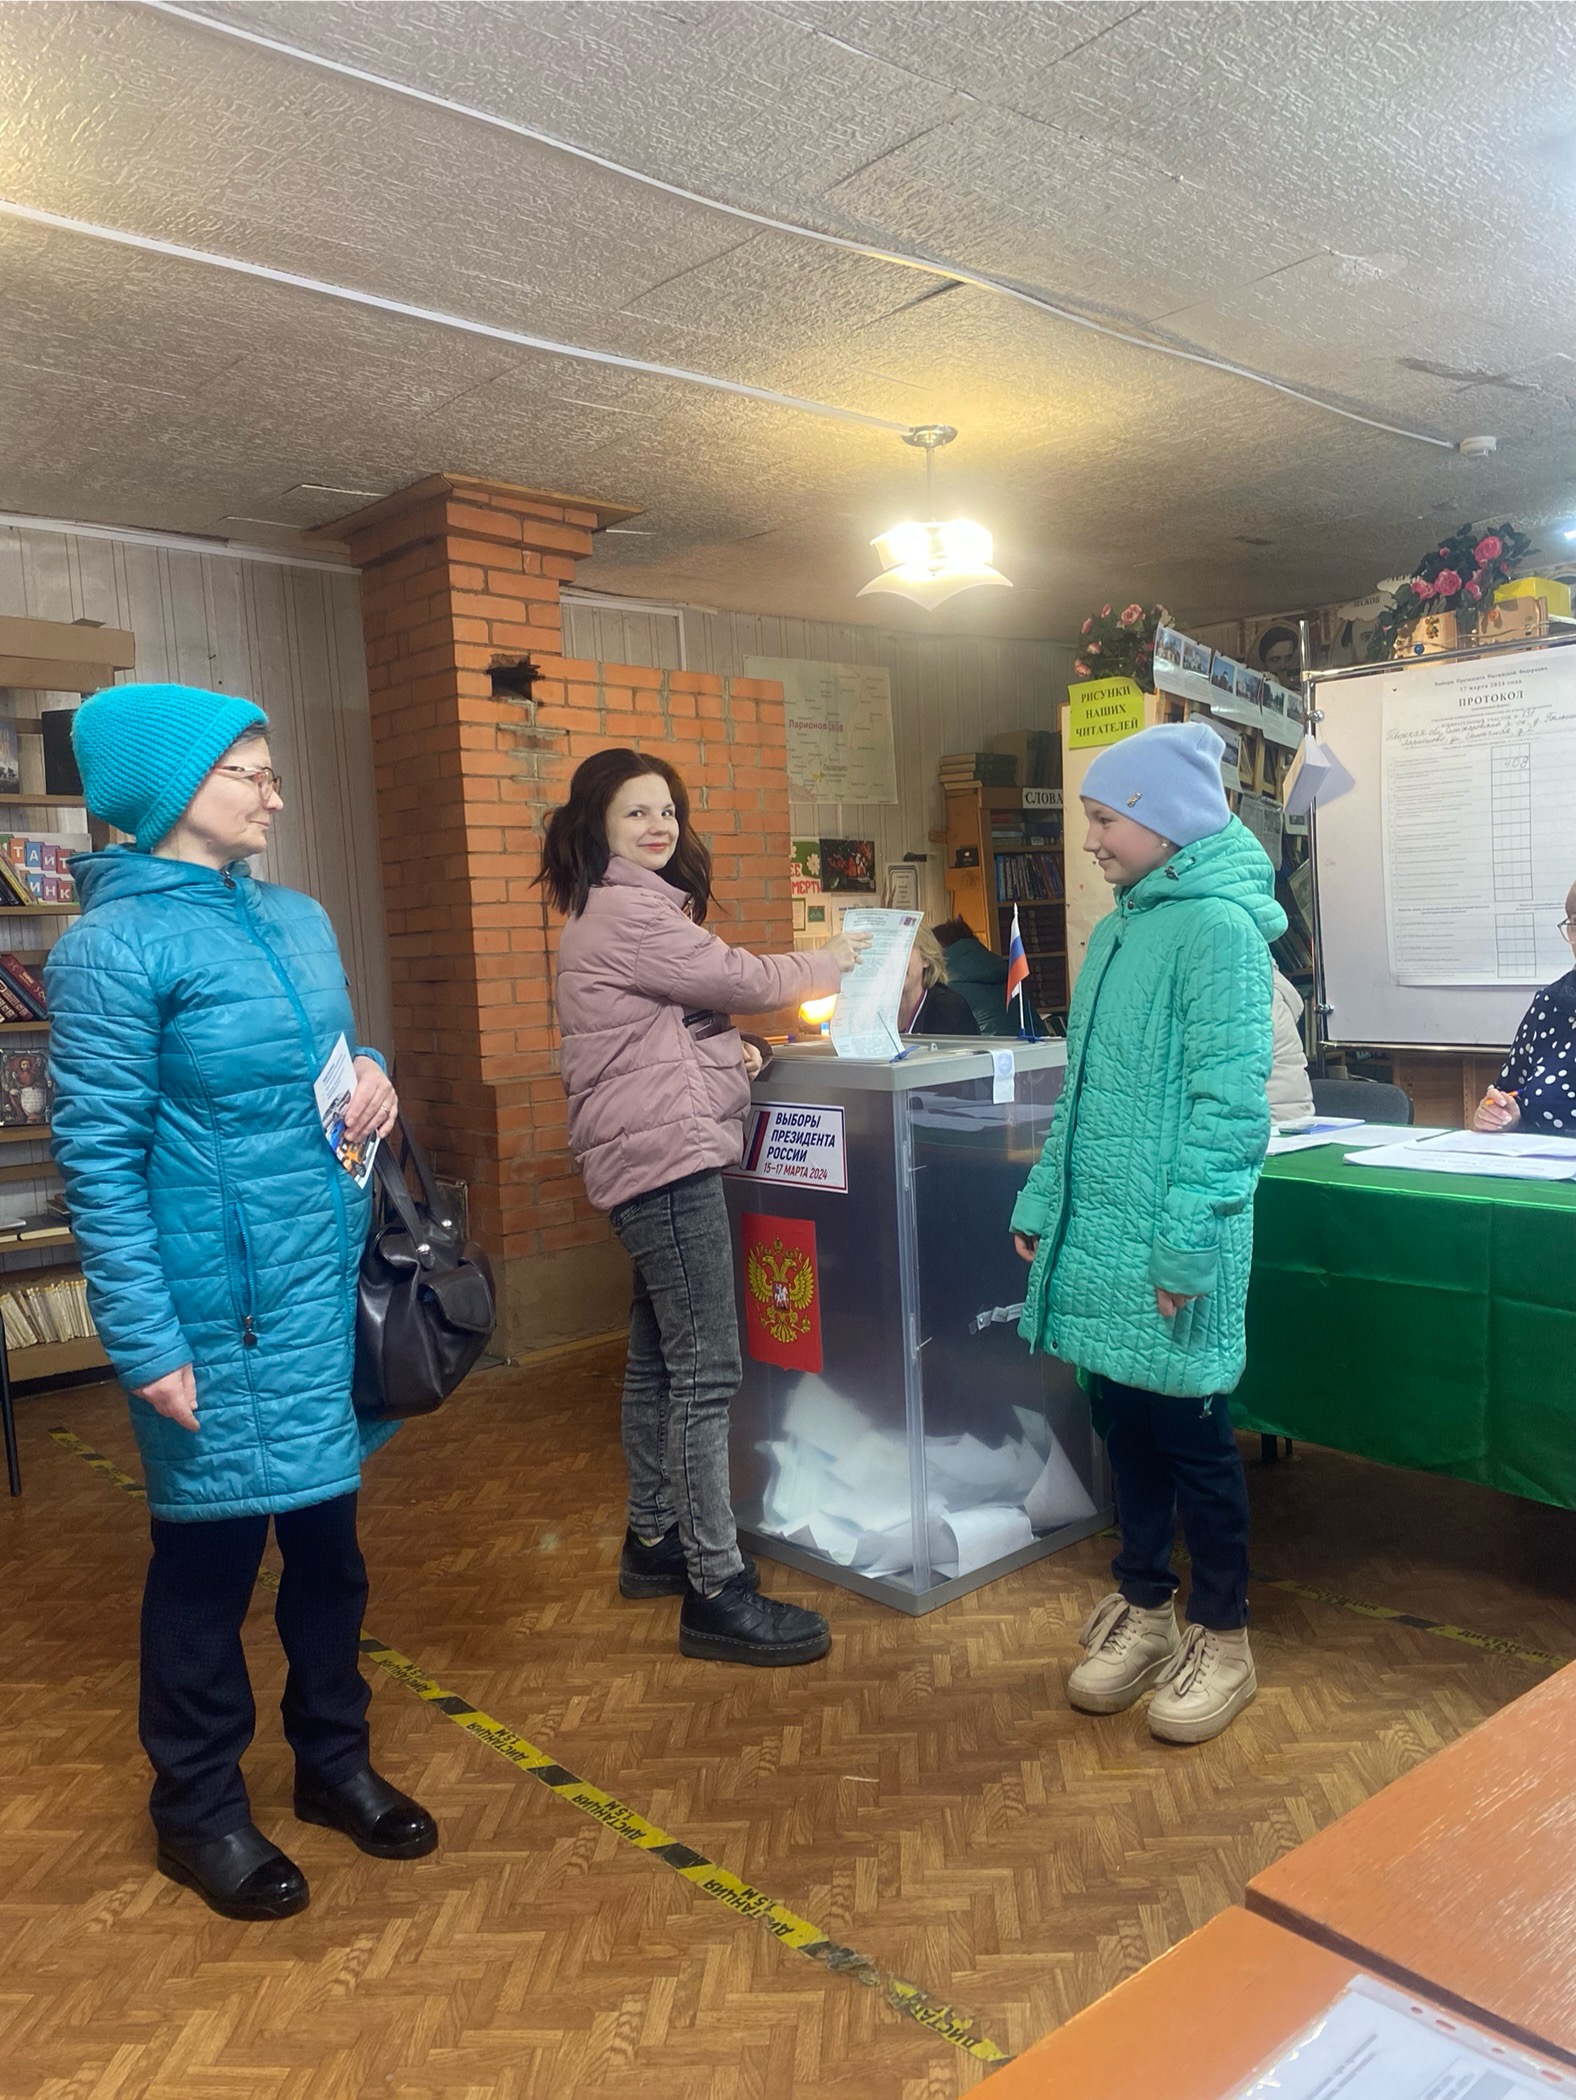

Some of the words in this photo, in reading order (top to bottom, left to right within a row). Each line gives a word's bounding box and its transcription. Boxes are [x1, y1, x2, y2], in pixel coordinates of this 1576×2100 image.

[1081, 685, 1131, 703] РИСУНКИ
[1458, 690, 1523, 707] ПРОТОКОЛ
[1086, 703, 1126, 719] НАШИХ
[1076, 717, 1138, 737] ЧИТАТЕЛЕЙ
[1025, 791, 1063, 805] СЛОВА
[775, 1112, 822, 1128] ВЫБОРЫ
[771, 1129, 836, 1148] ПРЕЗИДЕНТА
[766, 1146, 808, 1162] РОССИИ
[783, 1164, 809, 1178] МАРТА
[809, 1167, 828, 1180] 2024
[466, 1722, 529, 1762] ДИСТАНЦИЯ
[572, 1794, 647, 1840] ДИСТАНЦИЯ
[702, 1879, 795, 1937] ДИТАНЦИЯ
